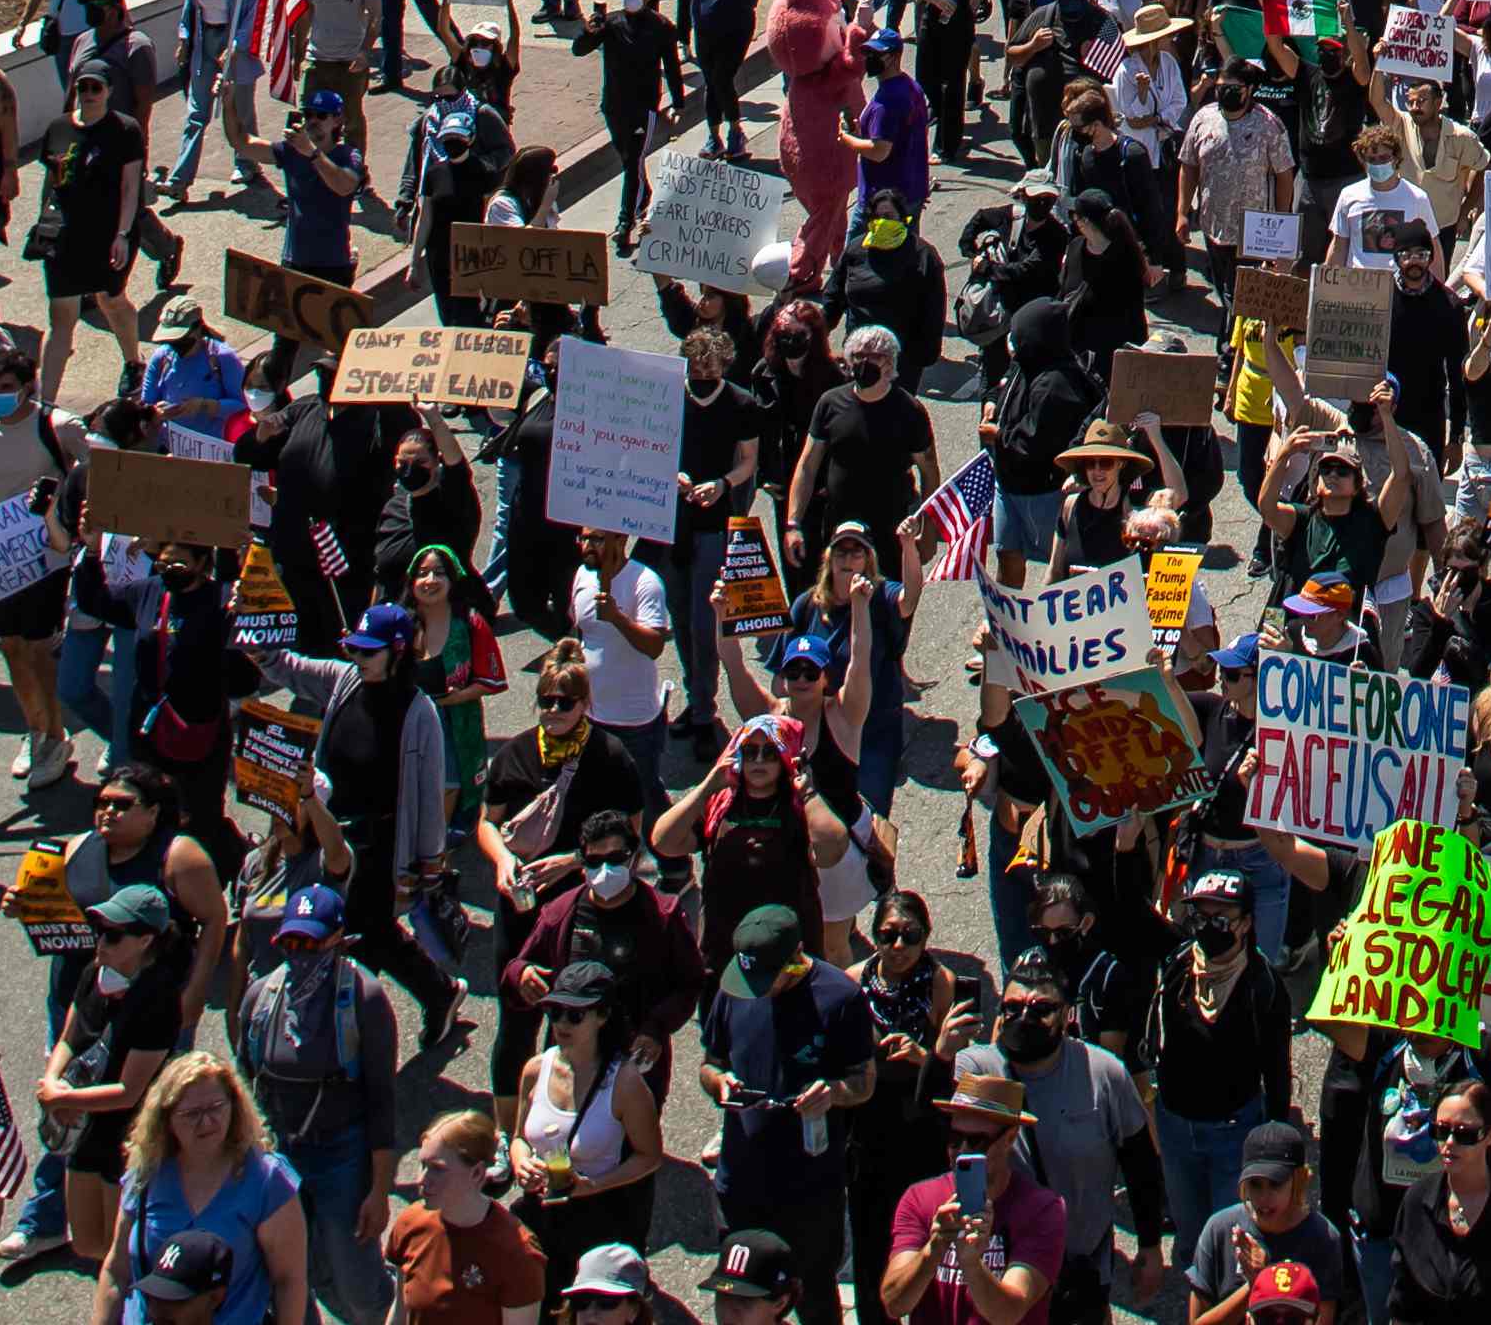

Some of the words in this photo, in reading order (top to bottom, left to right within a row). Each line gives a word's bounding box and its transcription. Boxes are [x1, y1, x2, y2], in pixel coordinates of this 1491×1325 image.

[679, 227, 715, 245] NOT
[453, 243, 507, 267] HANDS
[519, 246, 554, 270] OFF
[565, 250, 599, 276] LA
[647, 240, 749, 276] CRIMINALS
[412, 352, 440, 367] ON
[345, 368, 456, 393] STOLEN
[467, 374, 514, 399] LAND
[1166, 556, 1182, 567] The
[735, 565, 769, 579] TRUMP
[1154, 571, 1187, 585] Trump
[1146, 588, 1188, 602] Fascist
[235, 613, 275, 627] MUST
[280, 613, 298, 625] GO
[734, 615, 783, 633] AHORA!
[235, 628, 297, 645] NOW!!!
[1165, 629, 1181, 642] GO
[1259, 657, 1350, 735] COME
[1350, 670, 1406, 751] FOR
[1402, 679, 1469, 761] ONE
[1250, 727, 1350, 839] FACE
[1348, 737, 1403, 840] US
[27, 923, 71, 935] MUST
[72, 924, 91, 934] GO
[40, 934, 94, 949] NOW!!!
